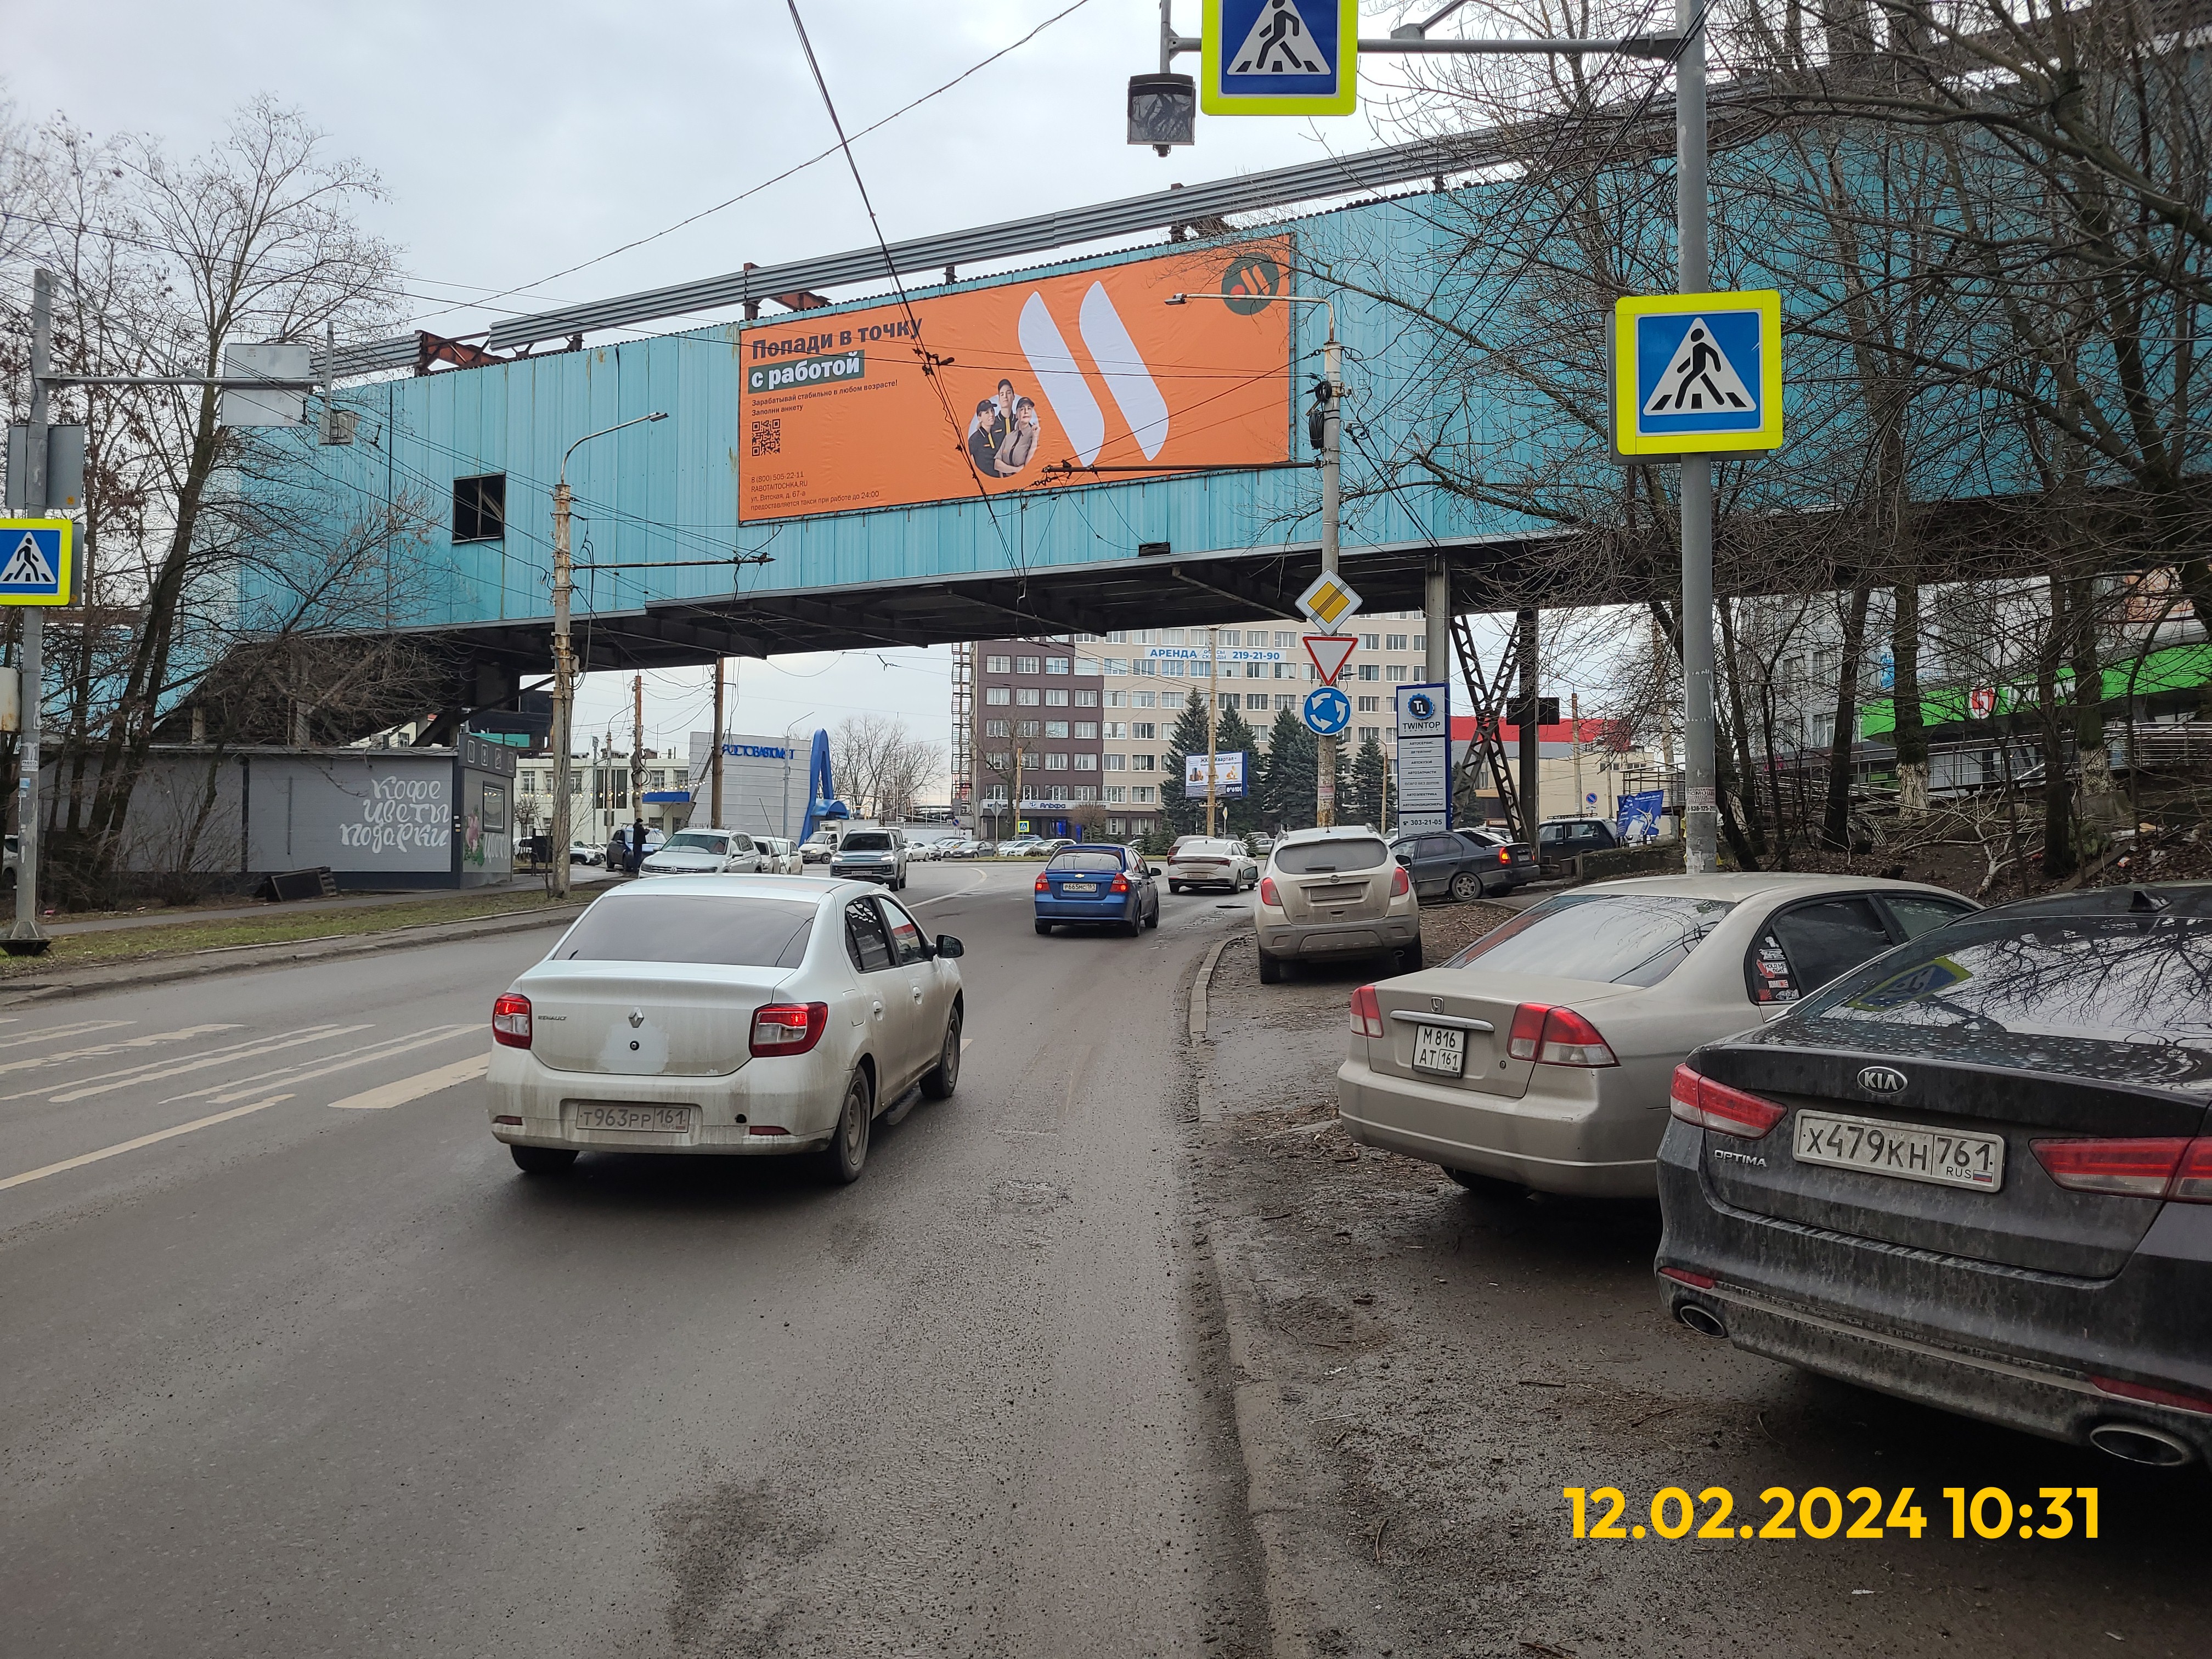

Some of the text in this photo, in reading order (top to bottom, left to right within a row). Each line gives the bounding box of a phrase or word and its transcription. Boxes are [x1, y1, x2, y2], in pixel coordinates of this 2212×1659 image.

[753, 318, 923, 360] Попади в точку
[751, 351, 860, 391] с работой
[752, 394, 796, 407] Зарабатывай
[798, 390, 832, 400] стабильно
[839, 386, 862, 394] любом
[864, 379, 898, 391] возрасте!
[752, 404, 803, 416] Заполни анкету
[756, 475, 772, 483] (800)
[772, 471, 804, 481] 505-22-11
[751, 480, 808, 493] RABOTAITOCHKA.RU
[751, 501, 799, 511] предоставляется
[830, 495, 851, 503] работе
[861, 490, 879, 499] 24:00
[1150, 649, 1198, 659] АРЕНДА
[1232, 651, 1280, 660] 219-21-90
[1402, 721, 1441, 730] TWINTOP
[723, 744, 794, 760] РОСТОВАВТОМТ
[1423, 1028, 1456, 1048] М 816
[1419, 1048, 1437, 1066] АТ
[1441, 1052, 1458, 1066] 161
[1864, 1071, 1898, 1090] KIA
[583, 1108, 684, 1128] Т963РР 161
[1805, 1124, 1990, 1172] Х479КН 761
[1714, 1149, 1767, 1167] OPTIMA
[1946, 1166, 1972, 1180] RUS
